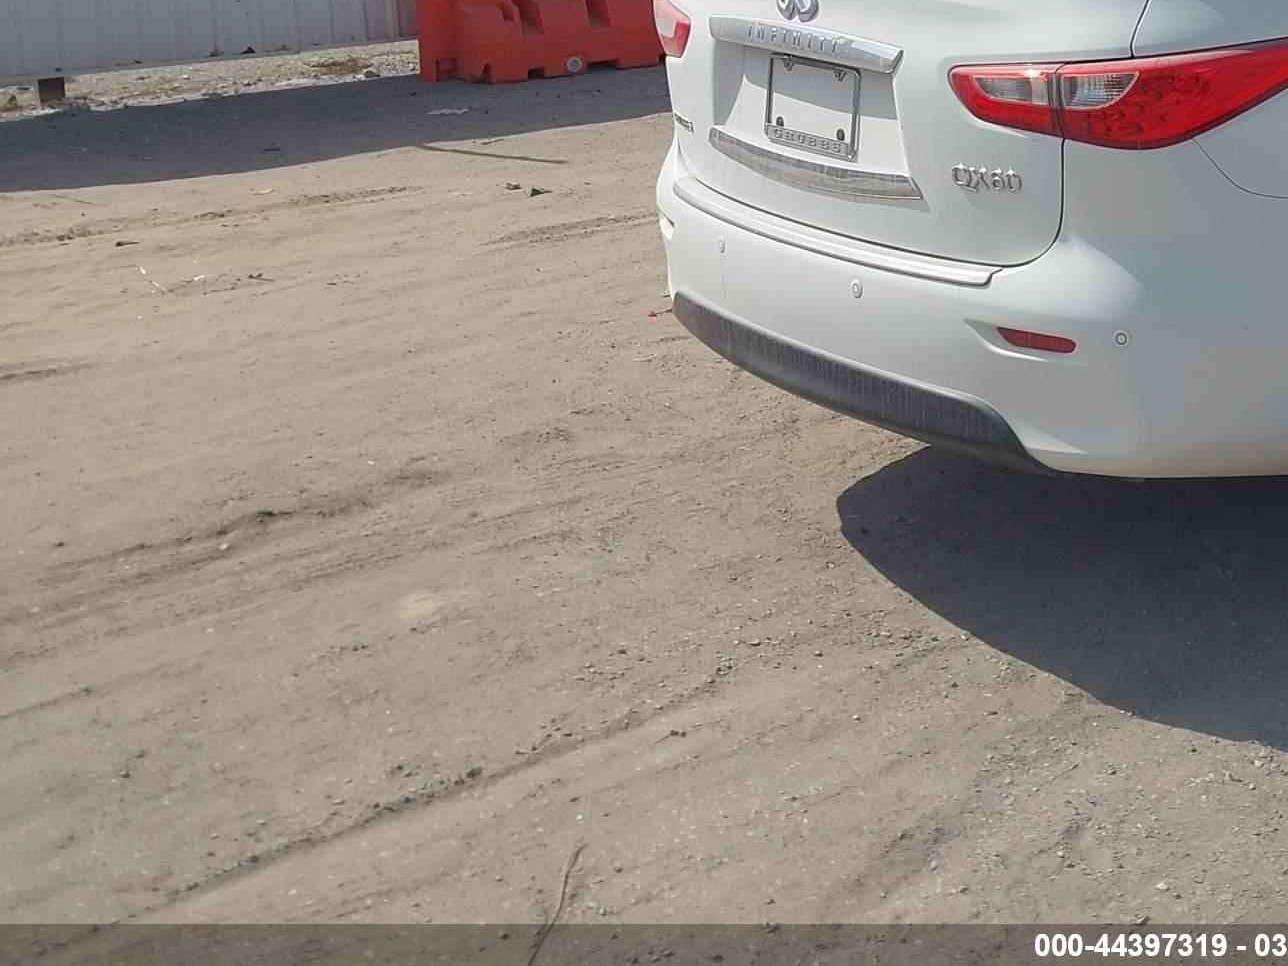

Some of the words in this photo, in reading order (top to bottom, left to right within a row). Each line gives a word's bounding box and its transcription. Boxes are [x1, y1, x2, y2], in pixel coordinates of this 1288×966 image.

[748, 23, 840, 54] INFINITI
[774, 128, 842, 153] GRUBBS
[951, 164, 1023, 194] QX60
